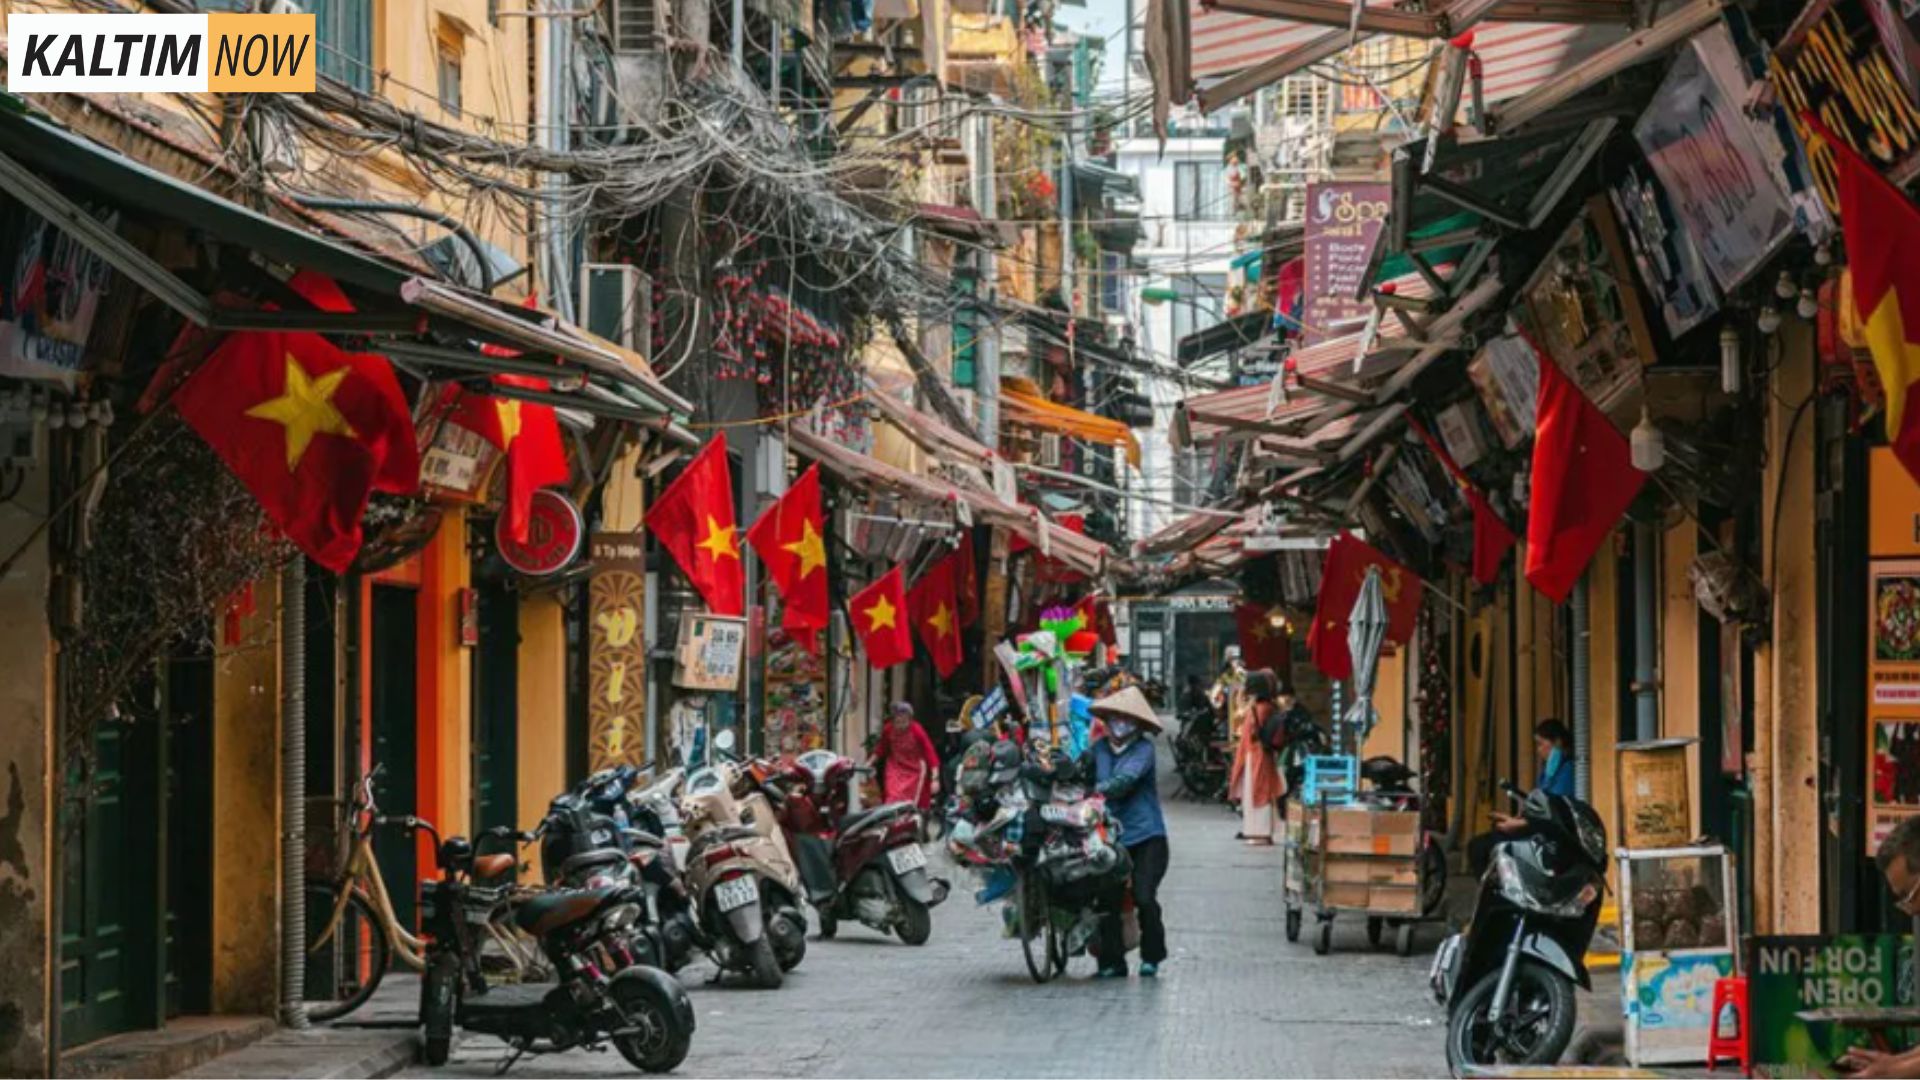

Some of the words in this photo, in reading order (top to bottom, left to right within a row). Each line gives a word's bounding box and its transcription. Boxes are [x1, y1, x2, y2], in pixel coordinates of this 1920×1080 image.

[1759, 946, 1816, 974] FUN
[1826, 946, 1882, 974] FOR
[1803, 977, 1883, 1005] OPEN
